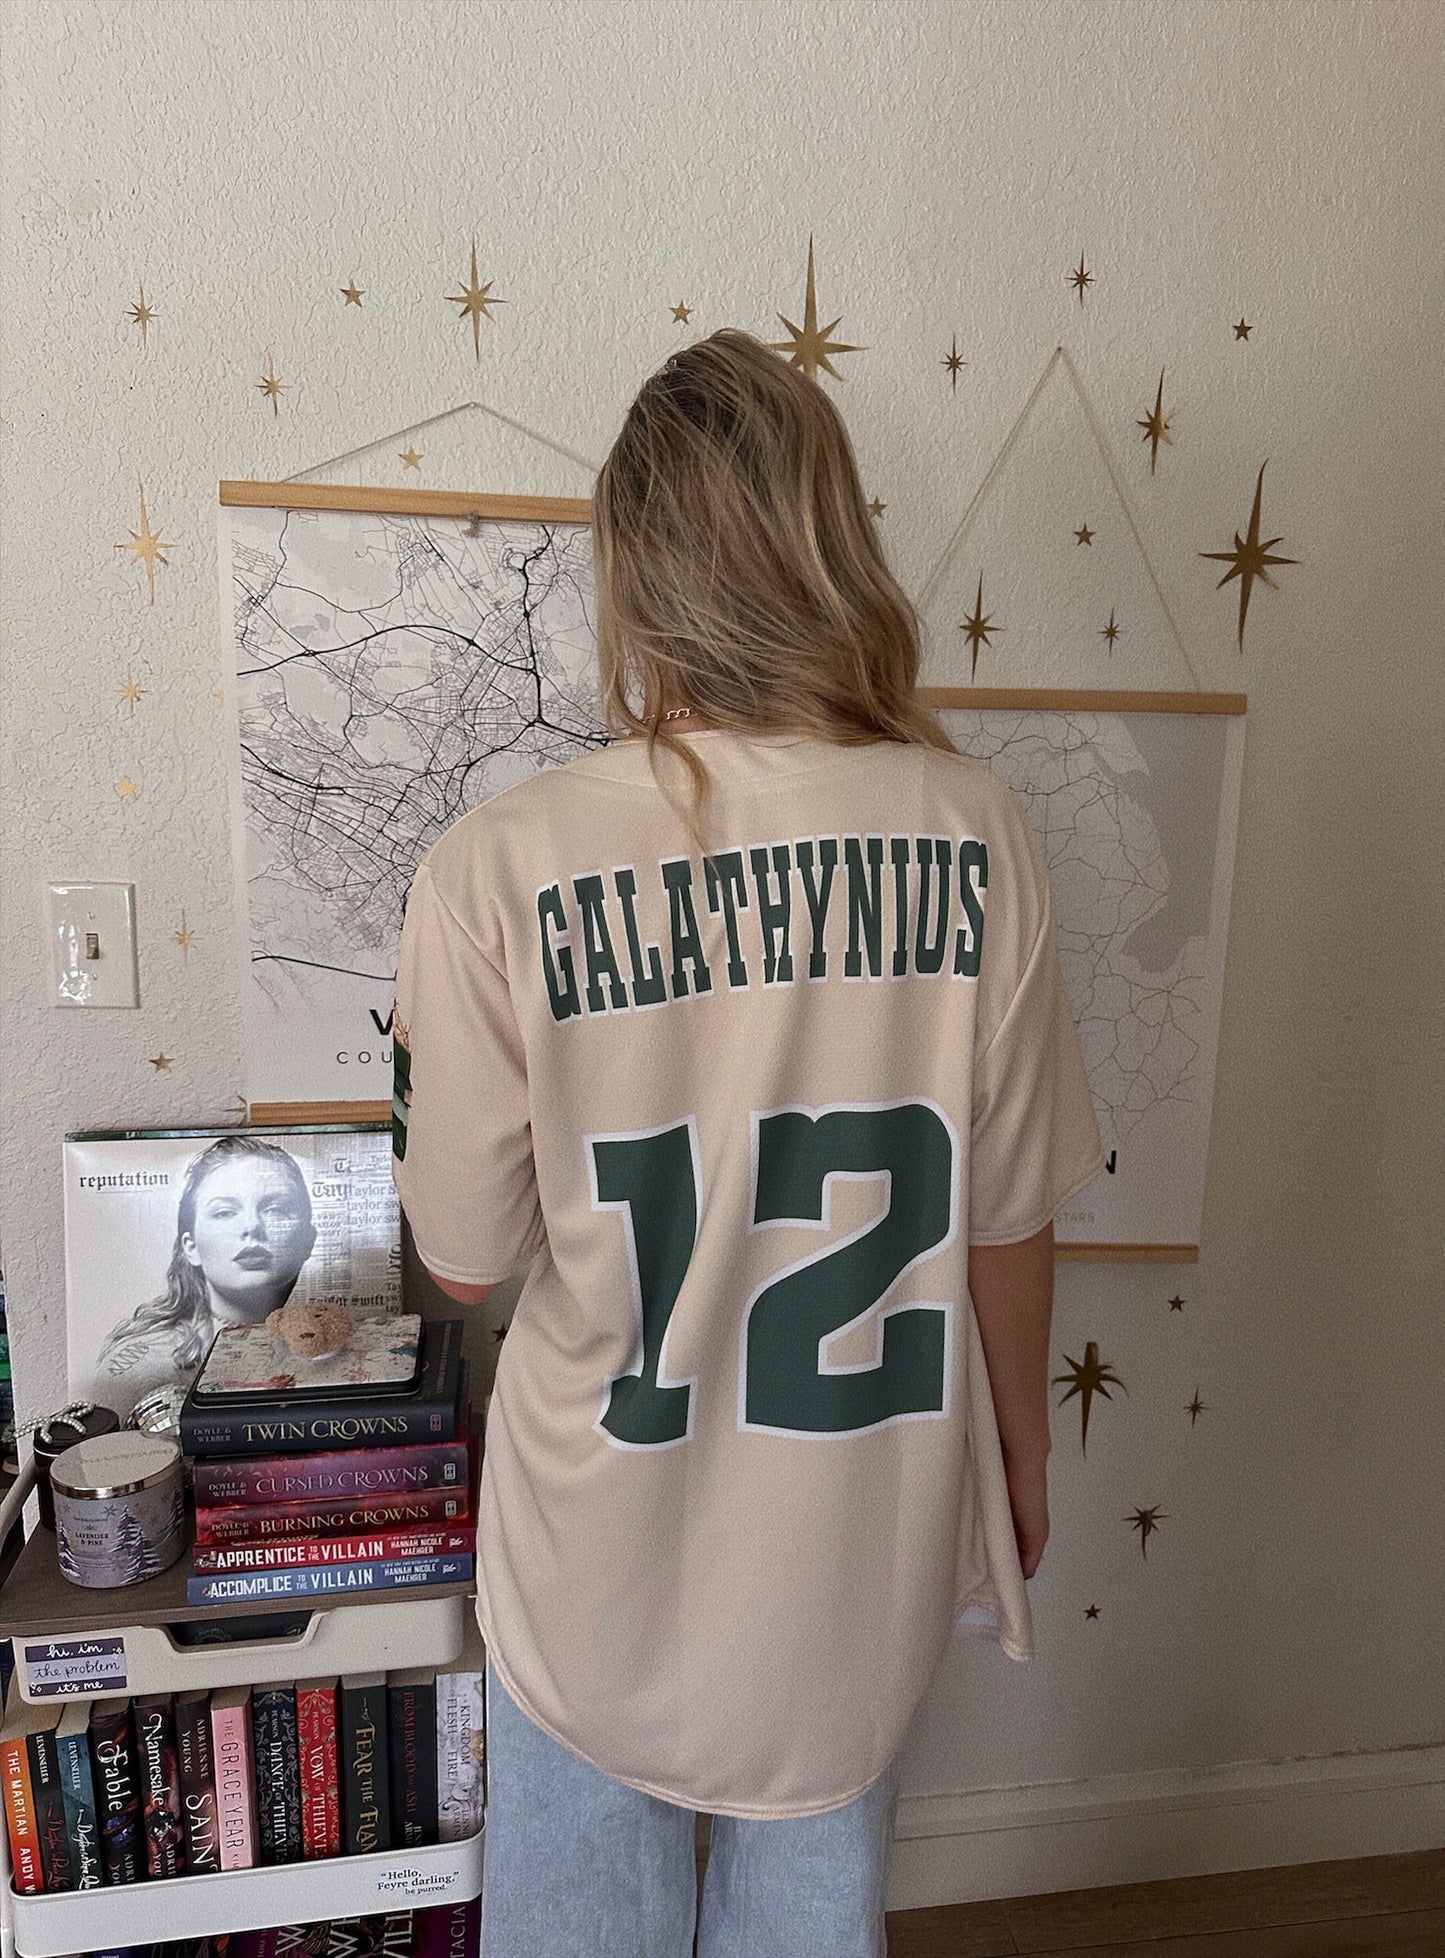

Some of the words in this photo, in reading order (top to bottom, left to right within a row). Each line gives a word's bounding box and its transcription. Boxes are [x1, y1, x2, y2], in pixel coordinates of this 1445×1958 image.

[536, 832, 988, 1024] GALATHYNIUS
[369, 1009, 394, 1035] V
[336, 1051, 393, 1065] COU
[79, 1171, 169, 1191] reputation
[583, 1095, 959, 1451] 12
[242, 1421, 306, 1442] TWIN
[311, 1416, 408, 1440] CROWNS
[208, 1482, 239, 1491] DOYLE
[256, 1474, 333, 1493] CURSED
[338, 1465, 429, 1489] CROWNS
[212, 1488, 247, 1497] WEBBER
[211, 1522, 240, 1532] DOYLE
[260, 1512, 345, 1534] BURNING
[349, 1504, 430, 1525] CROWNS
[75, 1531, 109, 1540] LAVENDER
[87, 1539, 104, 1547] PINE
[215, 1528, 250, 1538] WEBBER
[391, 1538, 419, 1549] HANNAH
[420, 1537, 443, 1547] NICOLE
[217, 1546, 306, 1568] APPRENTICE
[309, 1545, 318, 1553] TO
[308, 1553, 320, 1561] THE
[321, 1540, 384, 1561] VILLAIN
[311, 1568, 374, 1589] VILLAIN
[384, 1566, 412, 1577] HANNAH
[413, 1564, 436, 1574] NICOLE
[210, 1575, 293, 1599] ACCOMPLICE
[298, 1574, 306, 1582] TO
[296, 1582, 308, 1590] THE
[33, 1663, 61, 1679] the
[64, 1659, 121, 1678] problem
[56, 1682, 80, 1694] it's
[84, 1681, 104, 1691] me
[403, 1691, 415, 1728] FROM
[447, 1698, 457, 1734] FLESH
[223, 1720, 234, 1736] THE
[312, 1711, 320, 1740] PEARSON
[460, 1705, 471, 1765] KINGDOM
[36, 1735, 49, 1784] LEVENSELLER
[143, 1713, 171, 1806] Namesake
[181, 1730, 193, 1773] YOUNG
[197, 1718, 209, 1779] ADRIENNE
[353, 1722, 376, 1776] FEAR
[404, 1730, 416, 1773] BLOOD
[8, 1750, 21, 1775] THE
[68, 1741, 81, 1790] LEVENSELLER
[221, 1742, 242, 1801] GRACE
[270, 1741, 284, 1792] DANCE
[310, 1746, 325, 1782] VOW
[447, 1751, 458, 1777] FIRE
[97, 1741, 132, 1812] Fable
[360, 1777, 374, 1803] THE
[406, 1789, 417, 1813] ASH
[11, 1780, 29, 1836] MARTIAN
[225, 1805, 244, 1849] YEAR
[452, 1806, 461, 1840] ARMEN
[20, 1848, 34, 1880] ANDY
[123, 1853, 135, 1882] ADRI
[152, 1852, 163, 1877] YOU
[165, 1843, 177, 1876] ADRI
[377, 1880, 408, 1891] Feyre
[450, 1906, 466, 1958] TACIA
